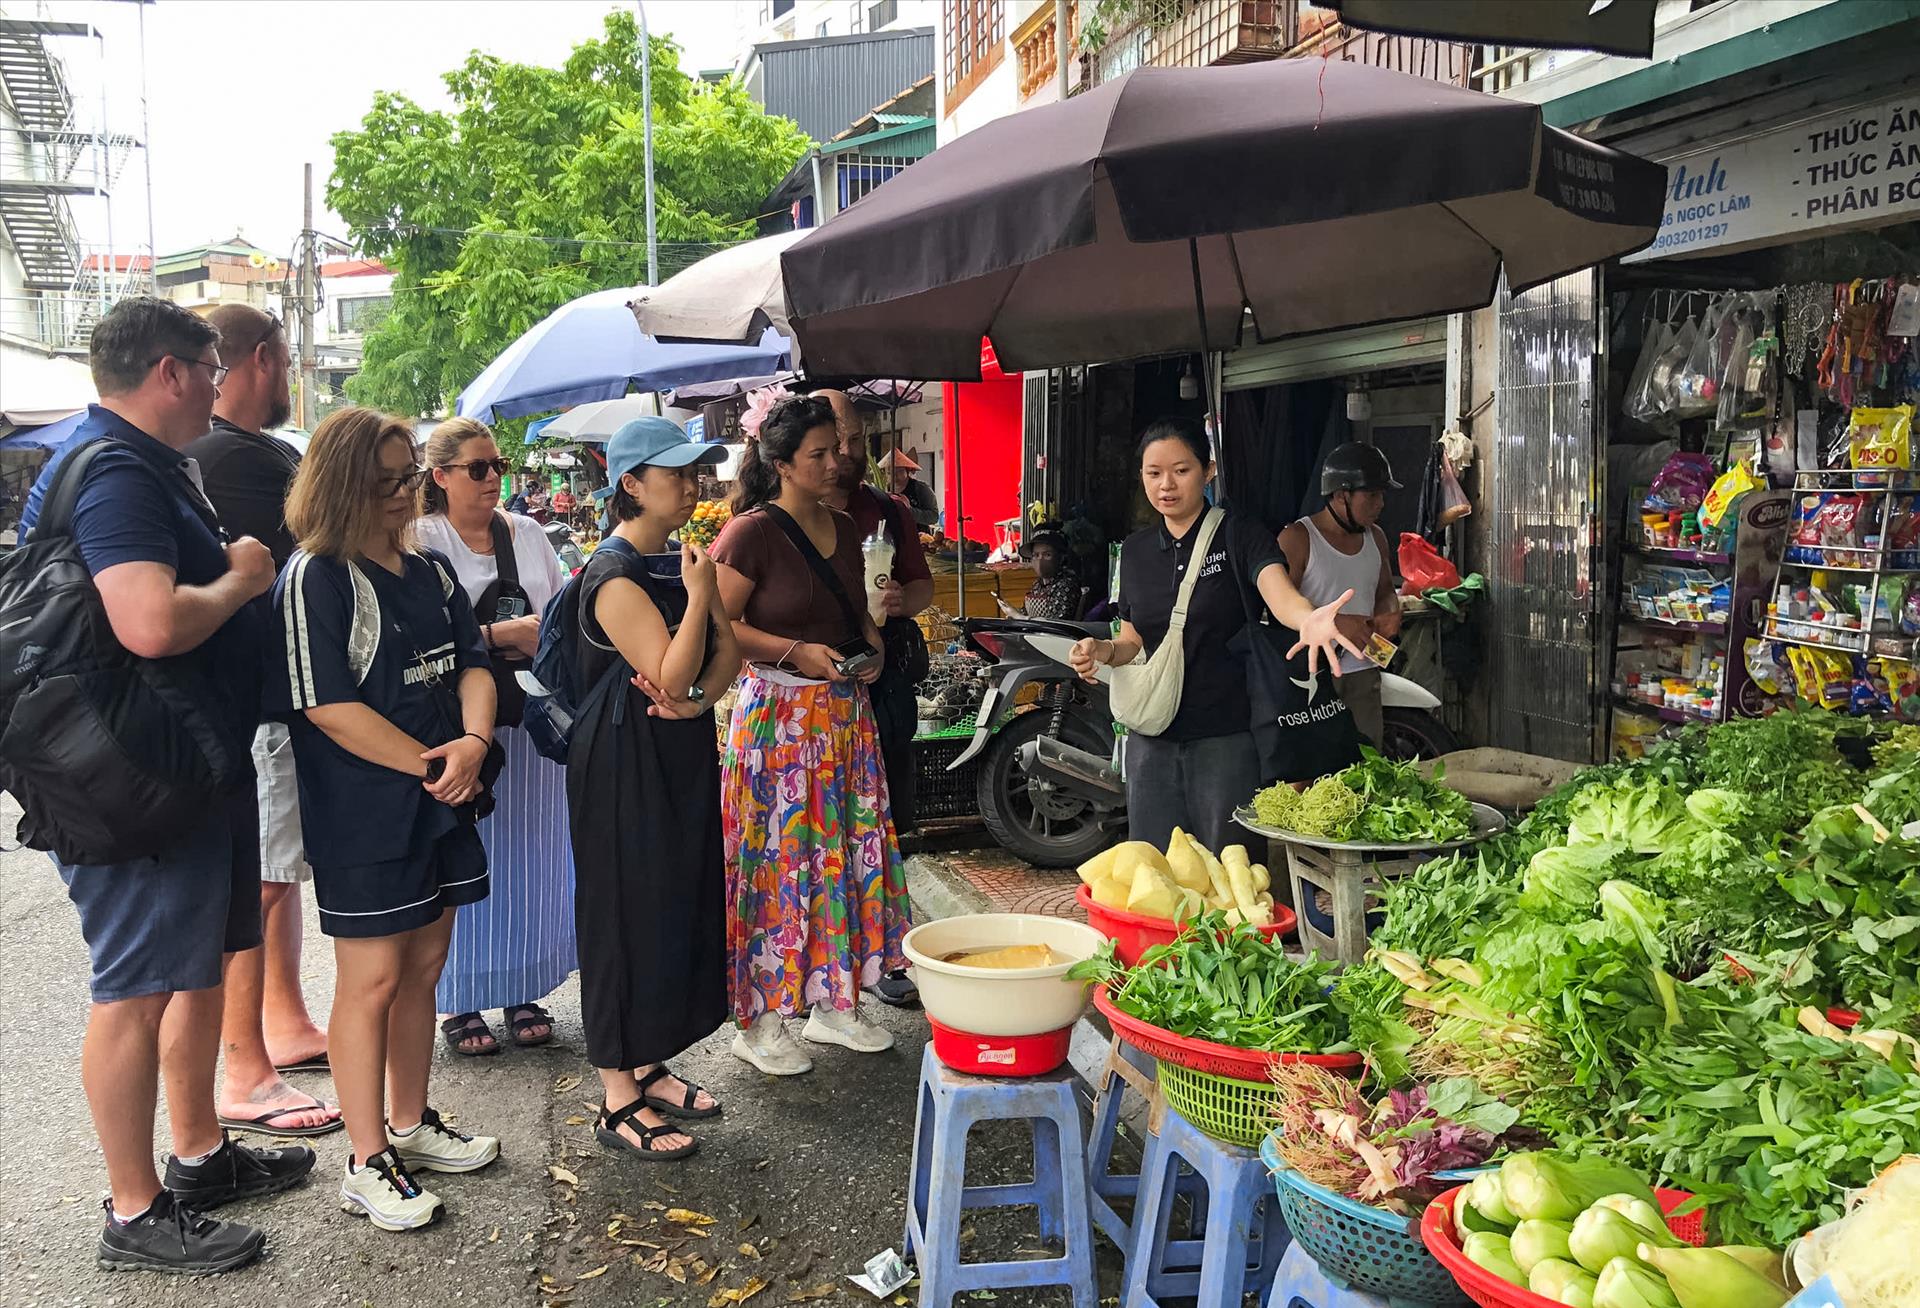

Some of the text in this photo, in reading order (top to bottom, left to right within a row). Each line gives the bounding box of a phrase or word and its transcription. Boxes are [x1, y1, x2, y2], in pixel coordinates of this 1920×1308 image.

[1807, 118, 1879, 154] THỨC
[1666, 157, 1728, 202] Anh
[1806, 151, 1878, 187] THỨC
[1677, 203, 1716, 223] NGỌC
[1720, 194, 1751, 215] LÂM
[1806, 185, 1879, 219] PHÂN
[1200, 563, 1222, 577] asia
[1277, 711, 1310, 727] rose
